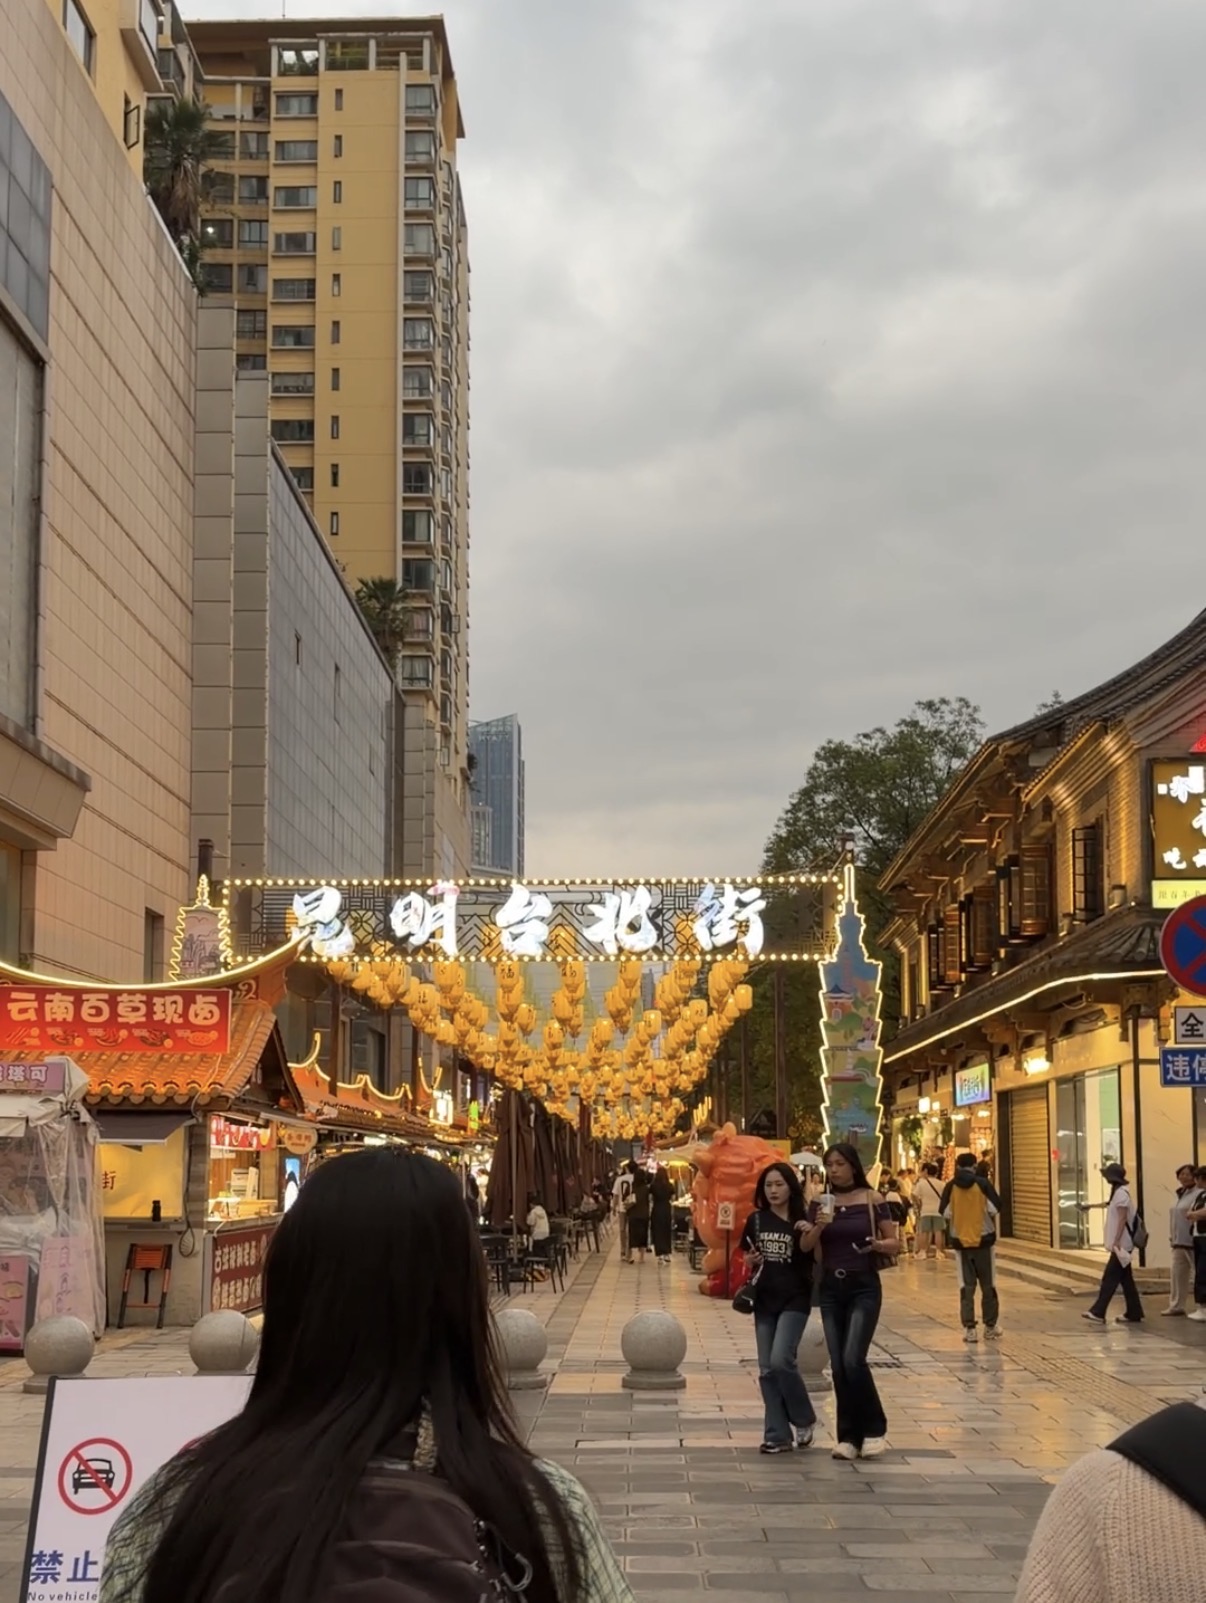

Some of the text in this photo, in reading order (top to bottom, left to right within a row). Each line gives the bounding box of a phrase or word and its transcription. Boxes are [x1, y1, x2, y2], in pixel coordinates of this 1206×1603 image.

[290, 882, 766, 958] 昆明台北街
[7, 991, 221, 1026] 云南百草现卤
[1181, 1012, 1204, 1038] 全
[0, 1064, 47, 1083] 塔可
[763, 1240, 786, 1254] 1983
[30, 1550, 99, 1584] 禁止
[28, 1591, 98, 1601] No vehicle
